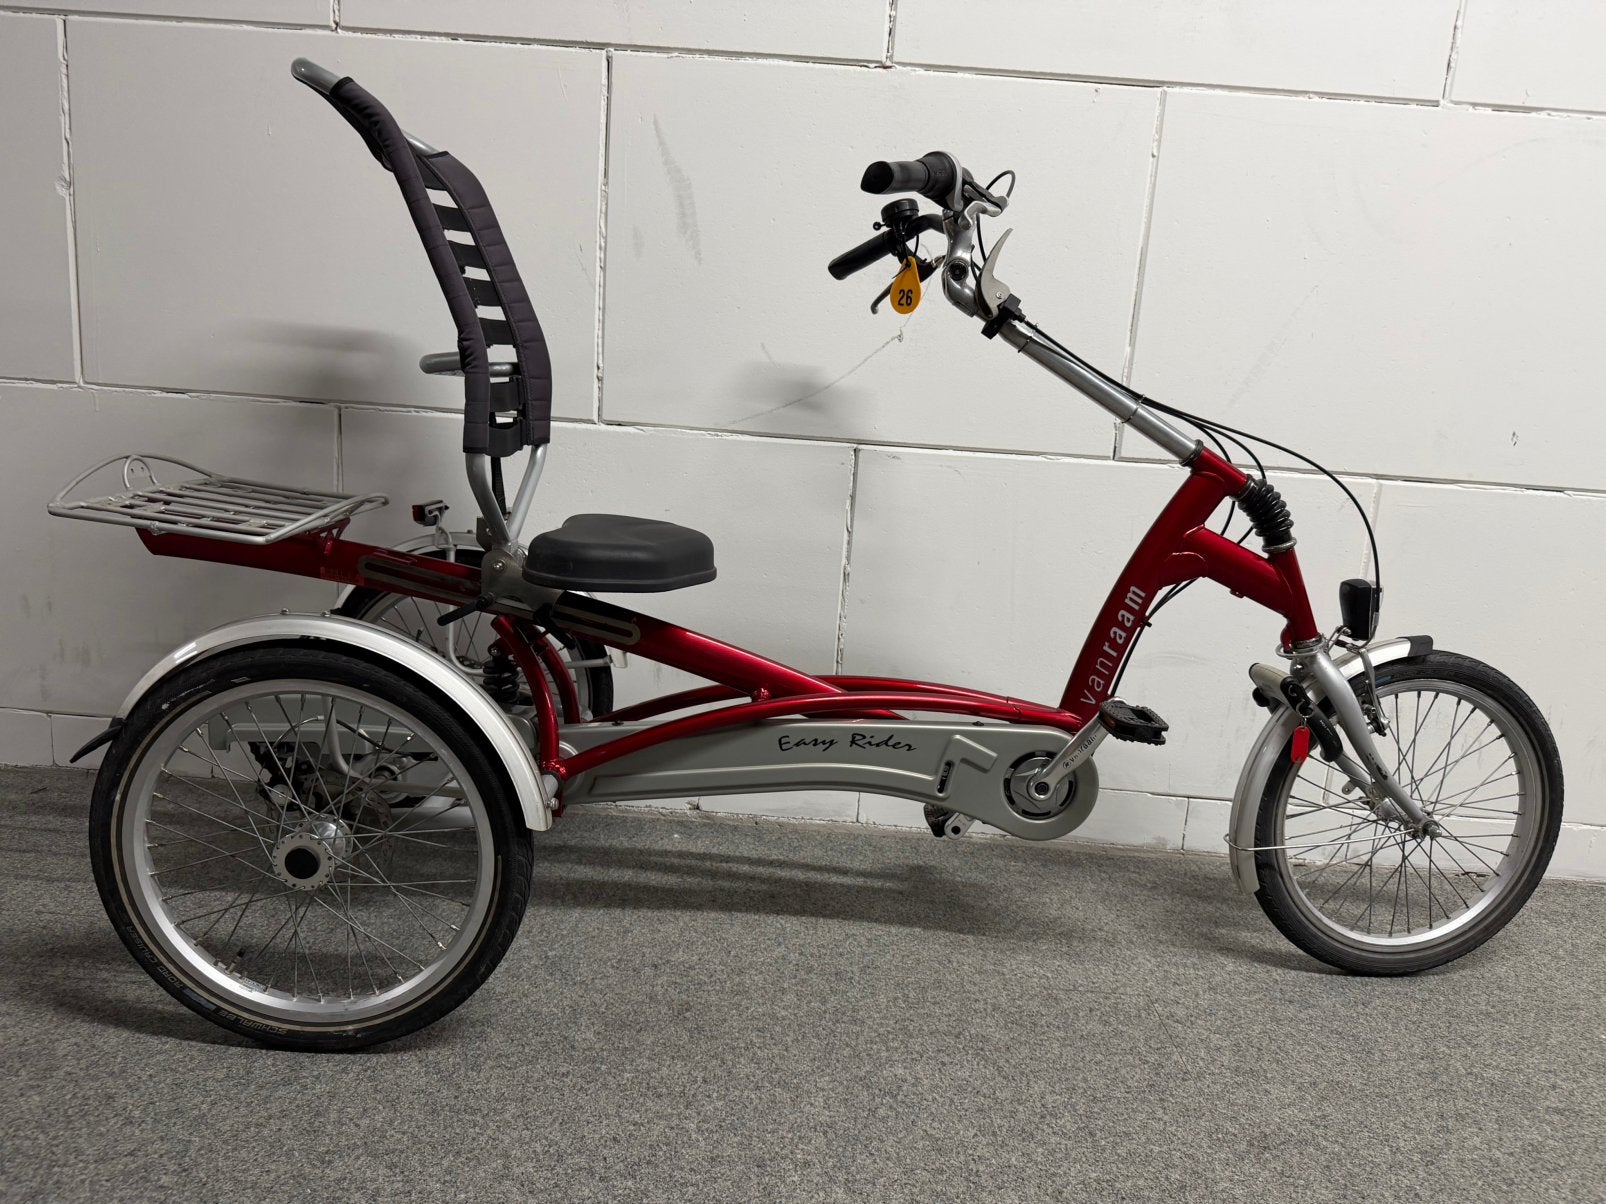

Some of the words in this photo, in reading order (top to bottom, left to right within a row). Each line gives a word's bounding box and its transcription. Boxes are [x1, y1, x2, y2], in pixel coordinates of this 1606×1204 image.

[897, 288, 913, 307] 26
[1080, 585, 1146, 705] vanraam
[777, 735, 838, 752] Easy
[849, 732, 917, 752] Rider
[127, 926, 157, 963] CRUISER
[157, 965, 185, 988] ROAD
[217, 1010, 288, 1035] SCHWALBE
